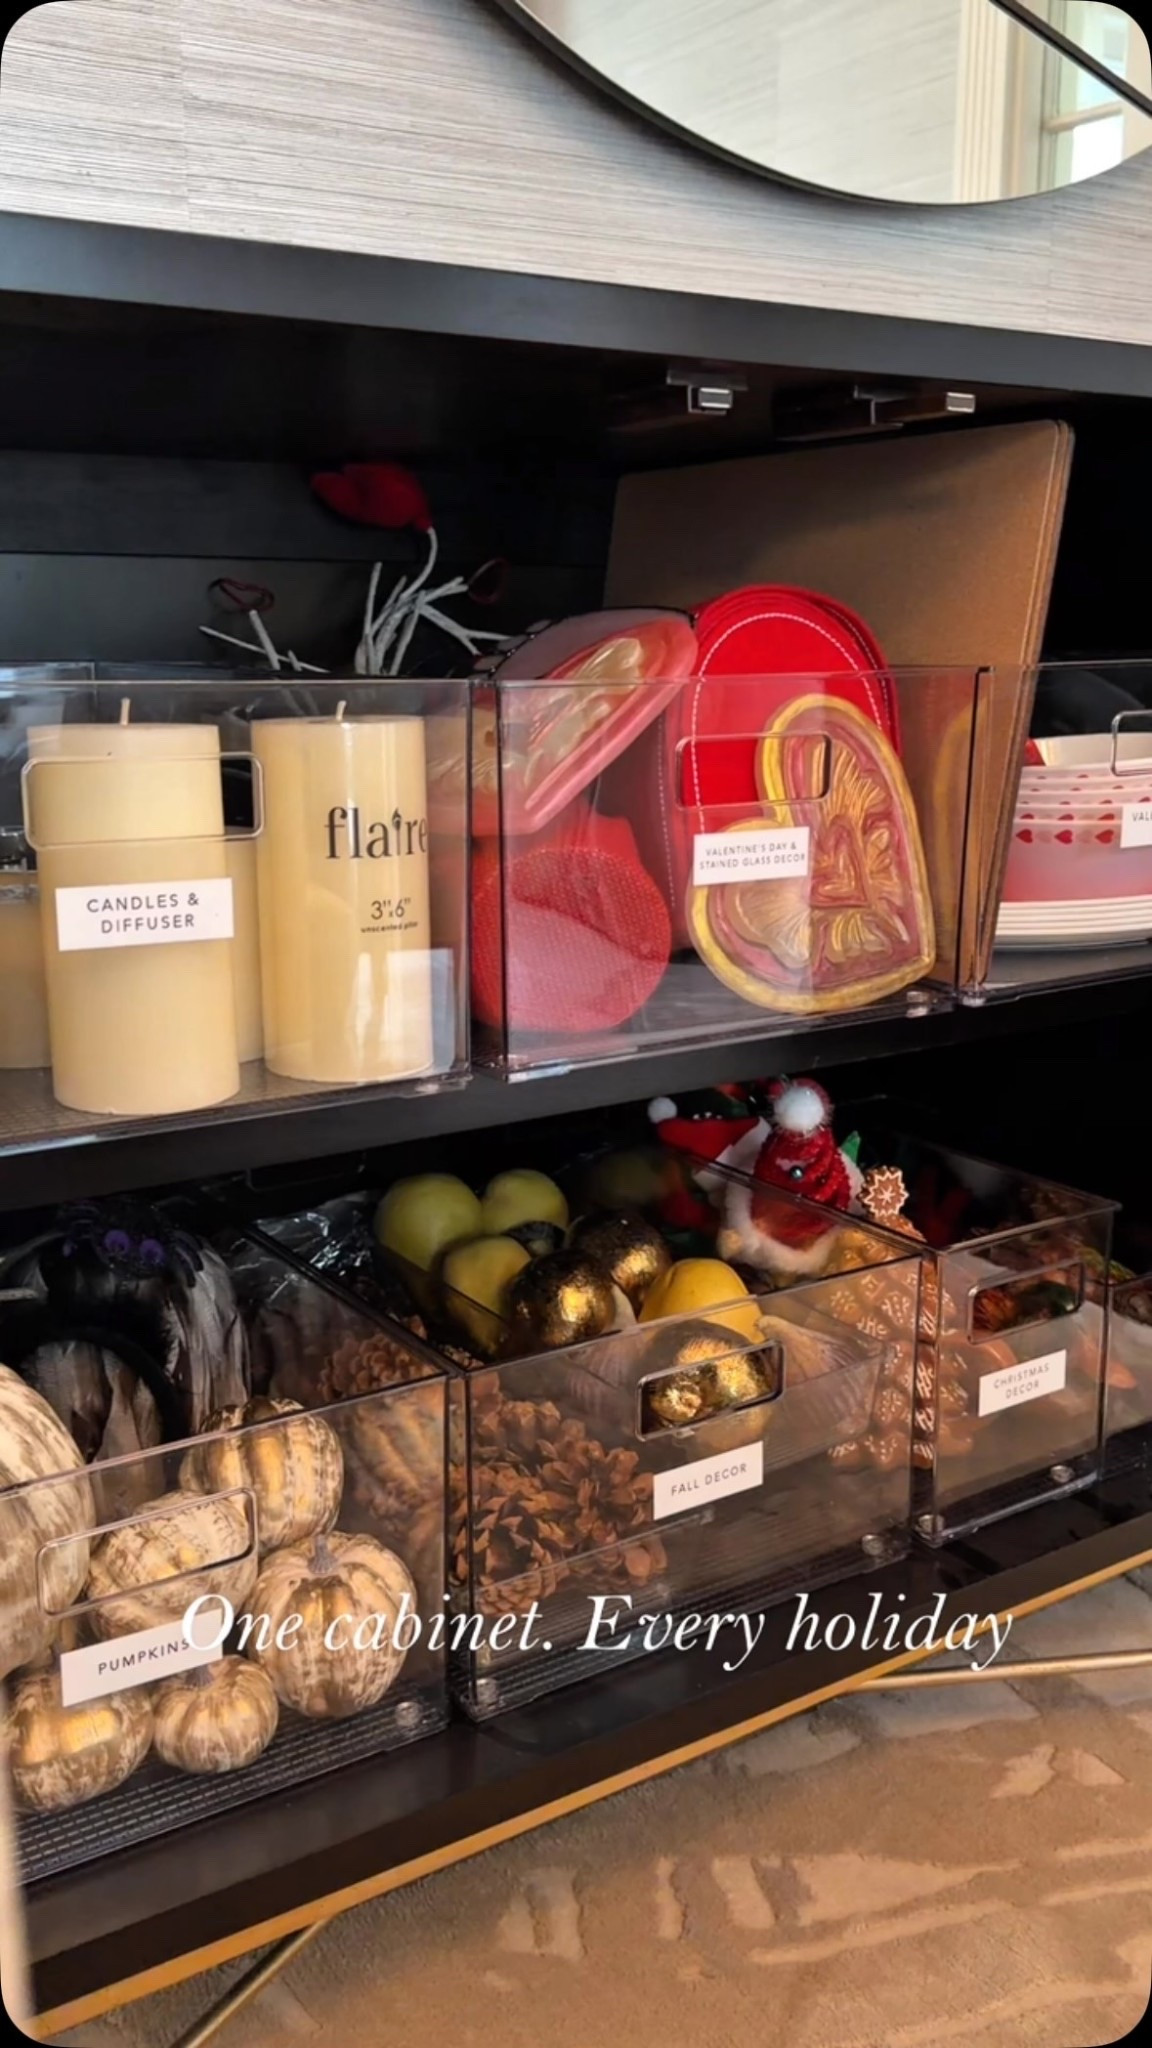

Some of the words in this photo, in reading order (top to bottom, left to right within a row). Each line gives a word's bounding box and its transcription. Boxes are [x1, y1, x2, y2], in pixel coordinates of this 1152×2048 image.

[324, 806, 428, 859] flaire
[706, 843, 767, 857] VALENTINE'S
[769, 842, 788, 852] DAY
[791, 841, 797, 850] &
[699, 858, 739, 870] STAINED
[742, 855, 771, 866] GLASS
[774, 852, 805, 864] DECOR
[86, 893, 179, 913] CANDLES
[187, 892, 199, 906] &
[101, 913, 195, 934] DIFFUSER
[993, 1362, 1050, 1389] CHRISTMAS
[1005, 1380, 1039, 1399] DECOR
[671, 1479, 700, 1496] FALL
[704, 1463, 747, 1485] DECOR
[98, 1638, 190, 1675] PUMPKINS
